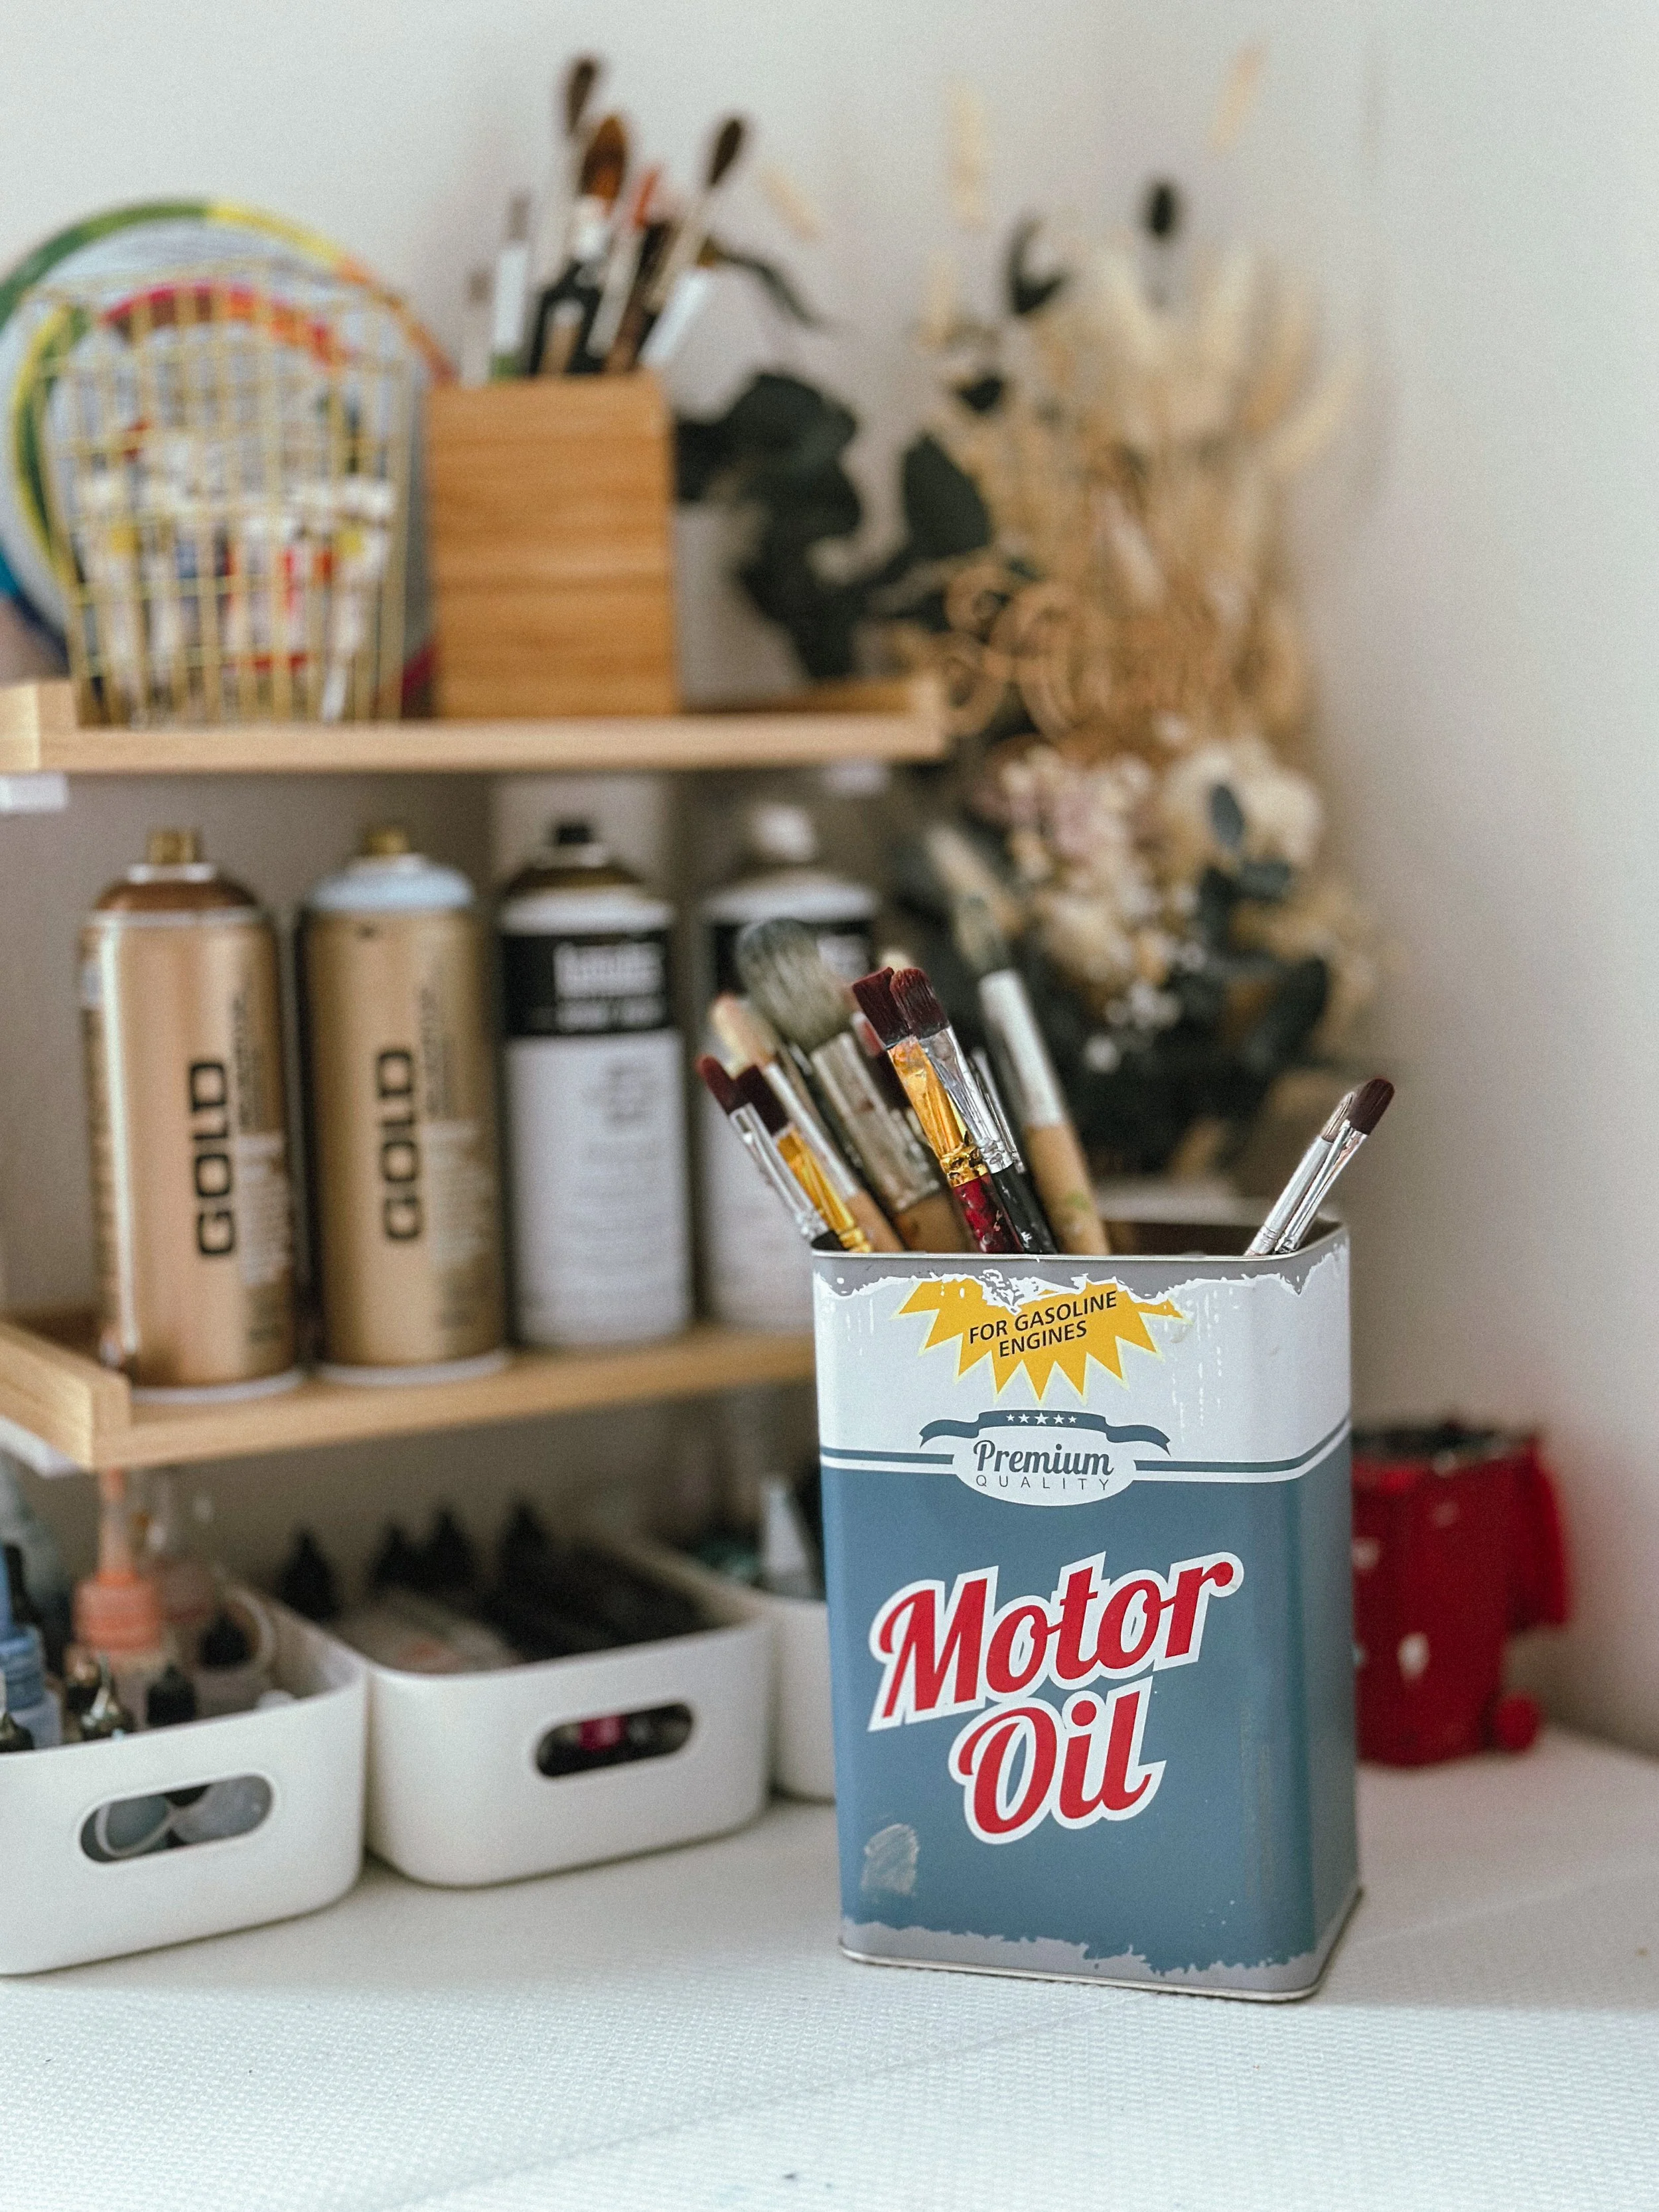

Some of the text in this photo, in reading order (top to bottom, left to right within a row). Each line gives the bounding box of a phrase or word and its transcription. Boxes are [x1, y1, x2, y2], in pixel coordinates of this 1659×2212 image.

[189, 1061, 234, 1256] GOLD
[377, 1049, 423, 1241] GOLD
[970, 1291, 1117, 1343] FOR GASOLINE
[999, 1320, 1087, 1357] ENGINES
[973, 1439, 1114, 1475] Premium
[976, 1475, 1109, 1491] QUALITY
[878, 1560, 1236, 1720] Motor
[956, 1688, 1153, 1835] Oil
